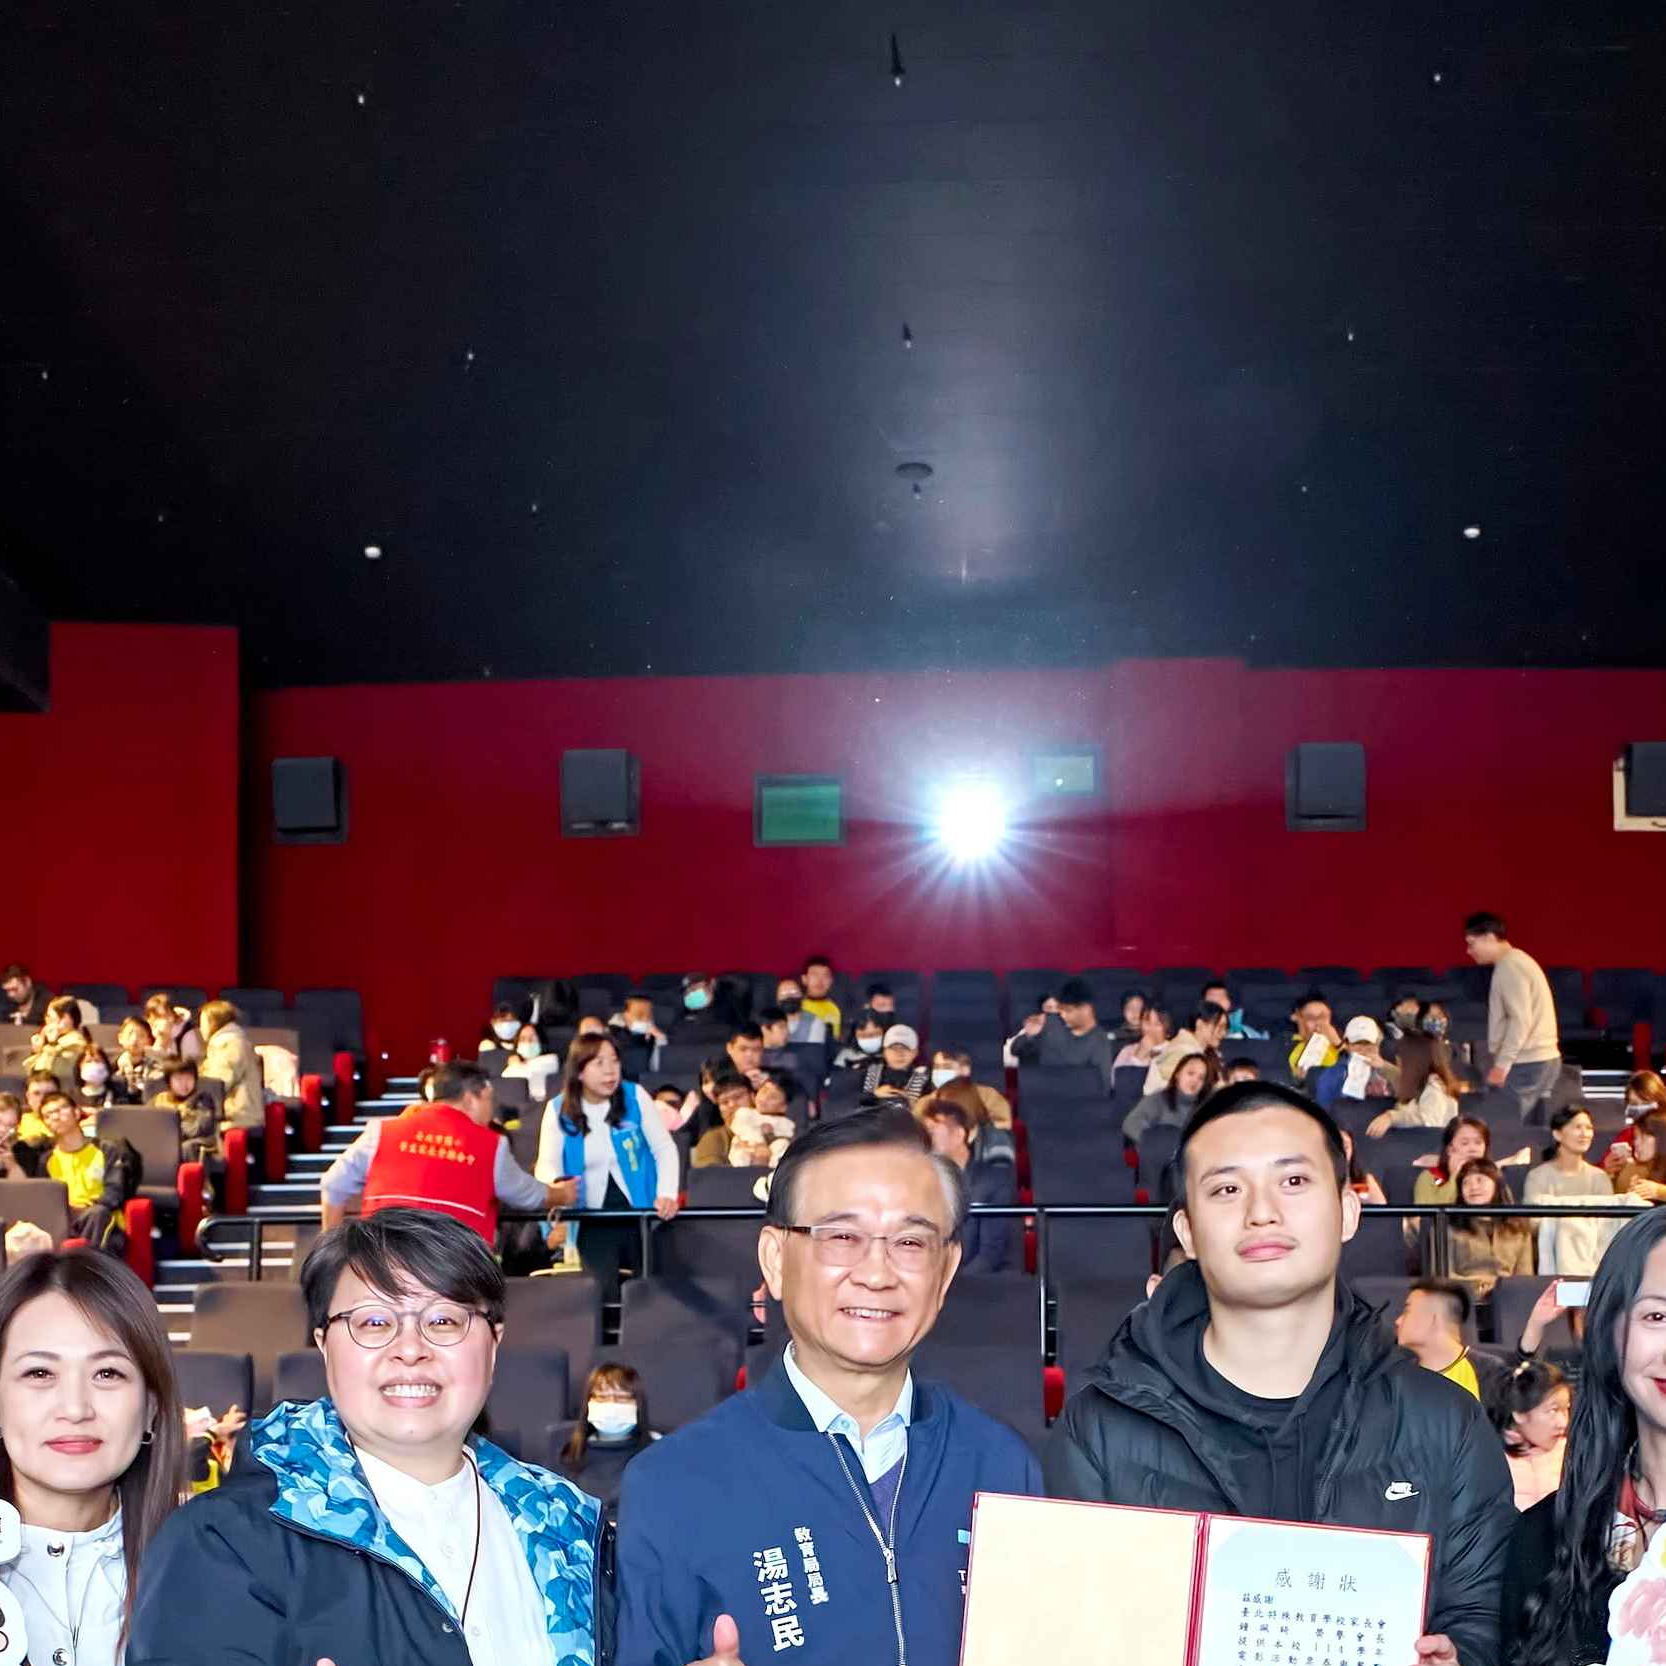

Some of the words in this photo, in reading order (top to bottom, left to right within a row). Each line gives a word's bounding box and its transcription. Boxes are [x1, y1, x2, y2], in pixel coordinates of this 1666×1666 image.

[753, 1547, 805, 1653] 湯志民
[1275, 1568, 1358, 1592] 感謝狀
